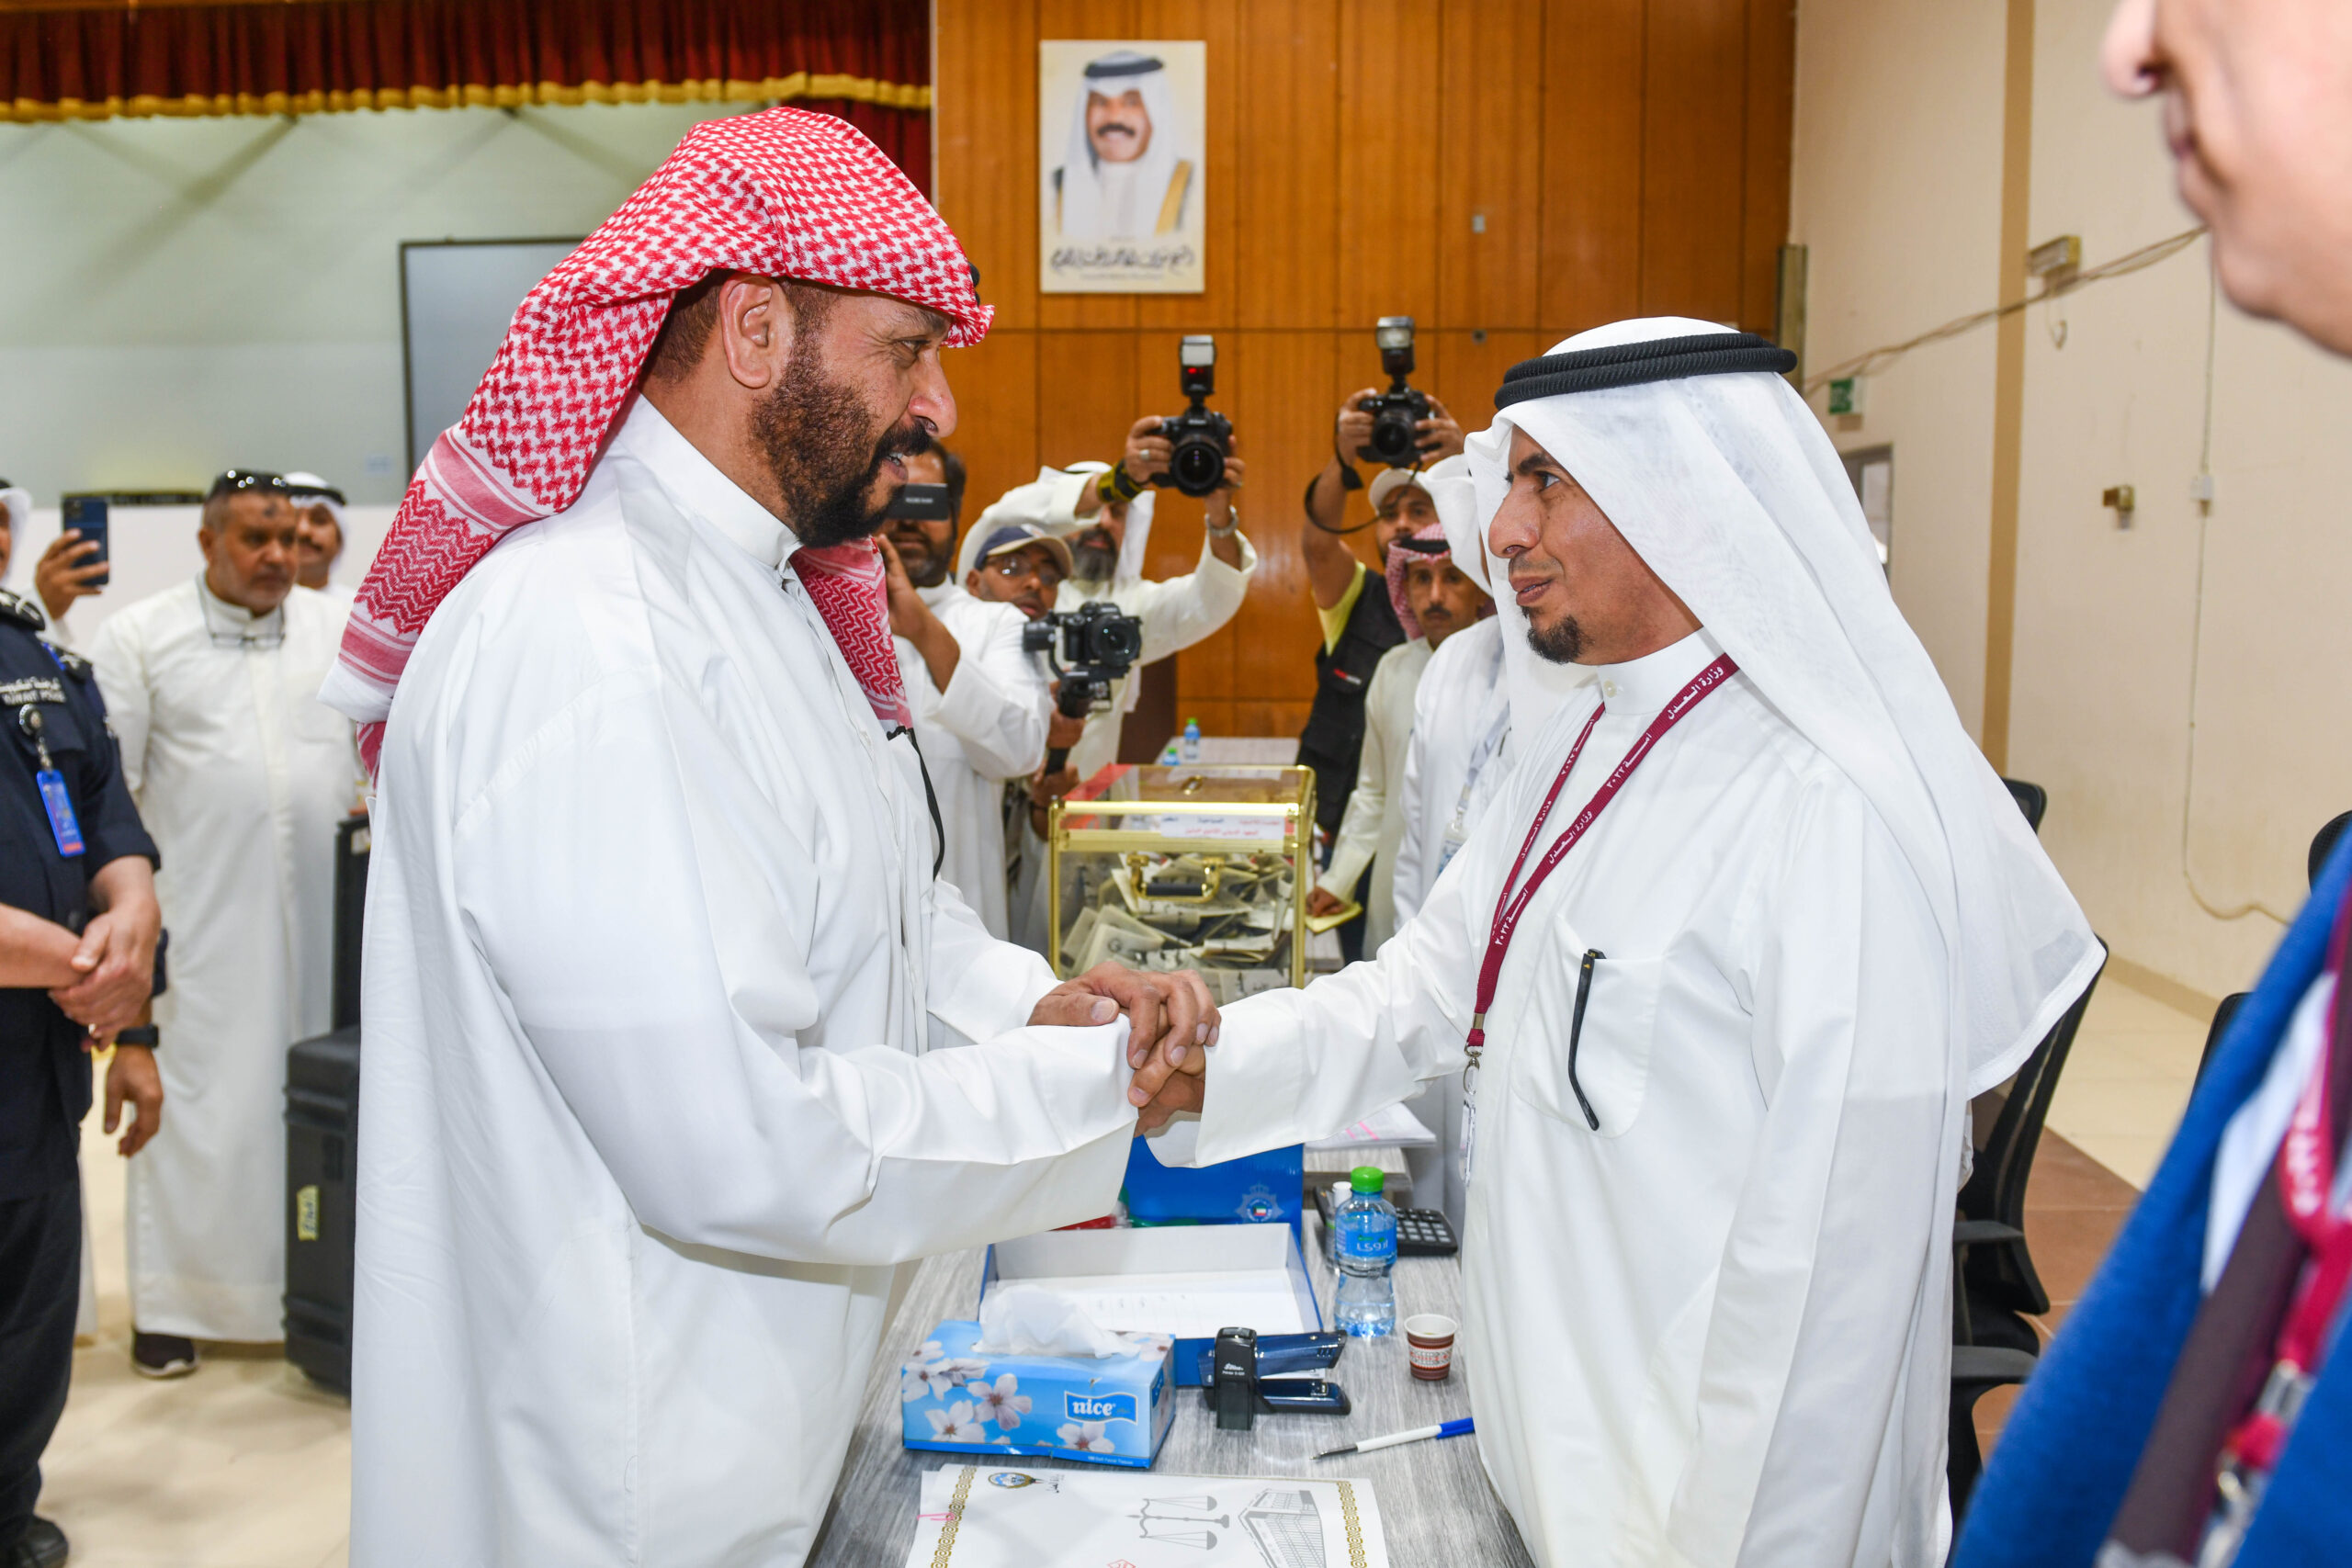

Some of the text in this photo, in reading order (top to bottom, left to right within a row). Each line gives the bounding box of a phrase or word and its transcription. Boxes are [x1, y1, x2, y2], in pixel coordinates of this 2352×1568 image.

[1699, 665, 1724, 687] وزارة
[1574, 810, 1593, 832] وزارة
[1072, 1398, 1113, 1416] nice
